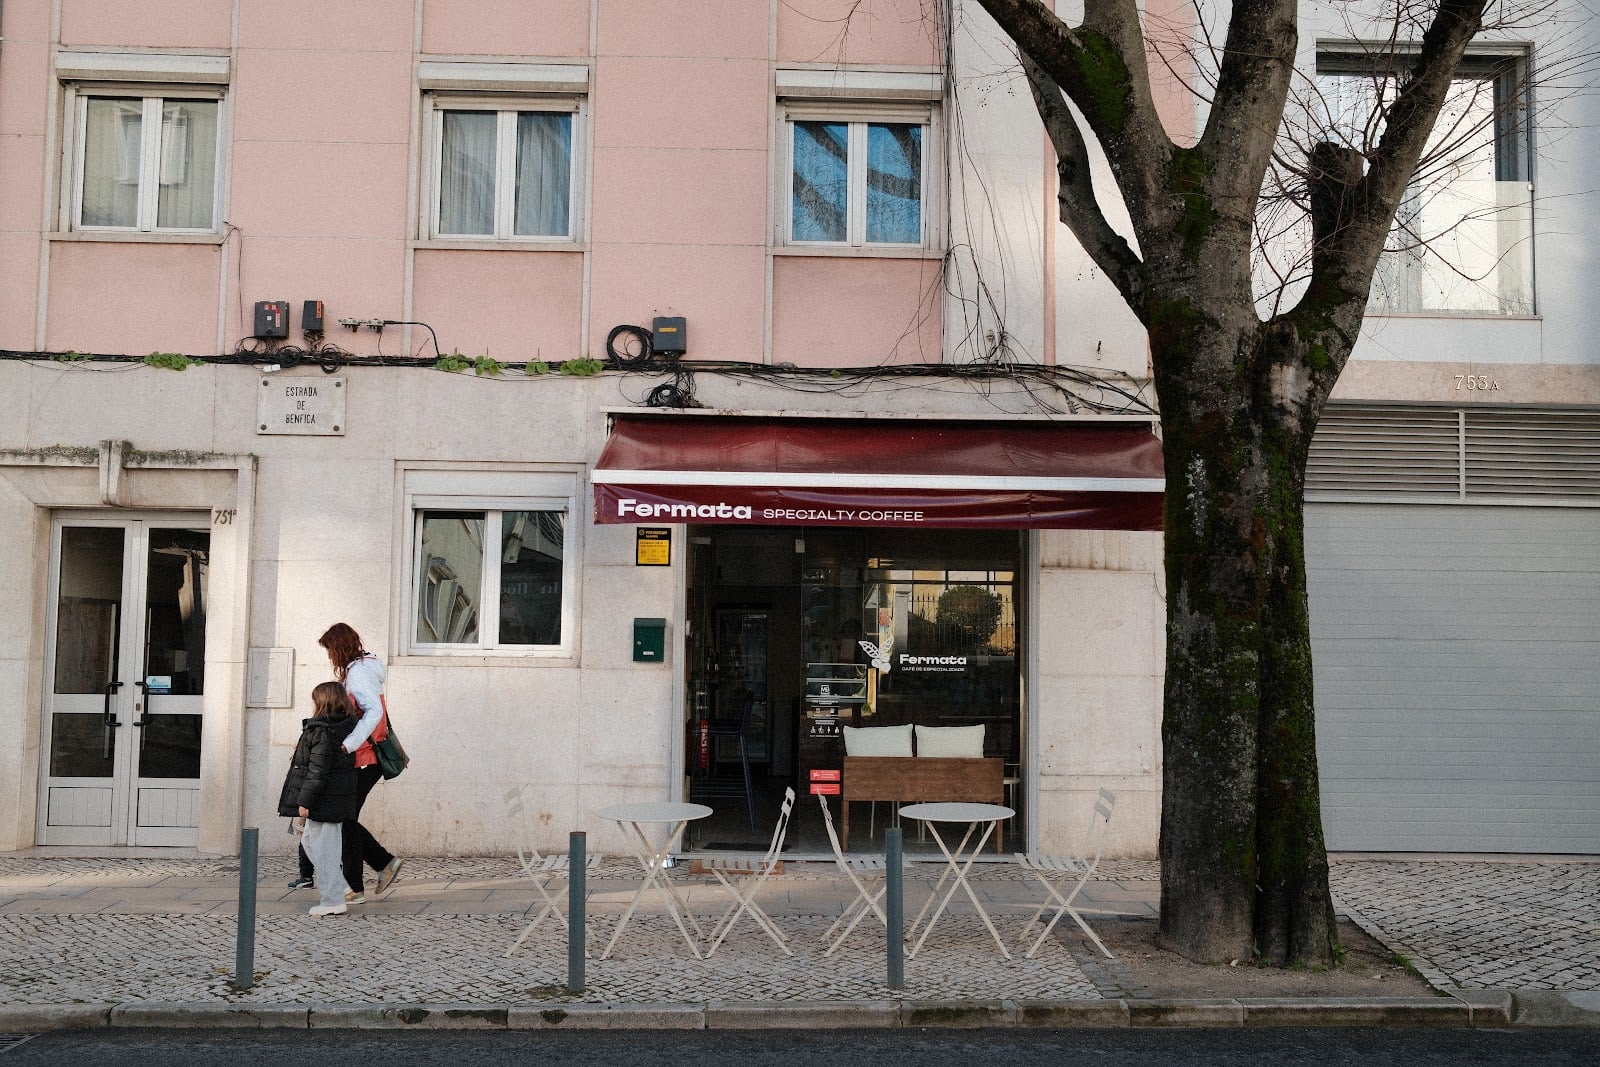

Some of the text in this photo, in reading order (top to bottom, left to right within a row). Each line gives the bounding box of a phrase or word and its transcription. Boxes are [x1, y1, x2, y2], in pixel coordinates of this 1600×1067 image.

[1454, 374, 1500, 391] 753A
[285, 386, 318, 397] ESTRADA
[296, 400, 306, 411] DE
[285, 413, 316, 424] BENFICA
[617, 498, 924, 522] Fermata SPECIALTY COFFEE
[899, 653, 966, 665] Fermata
